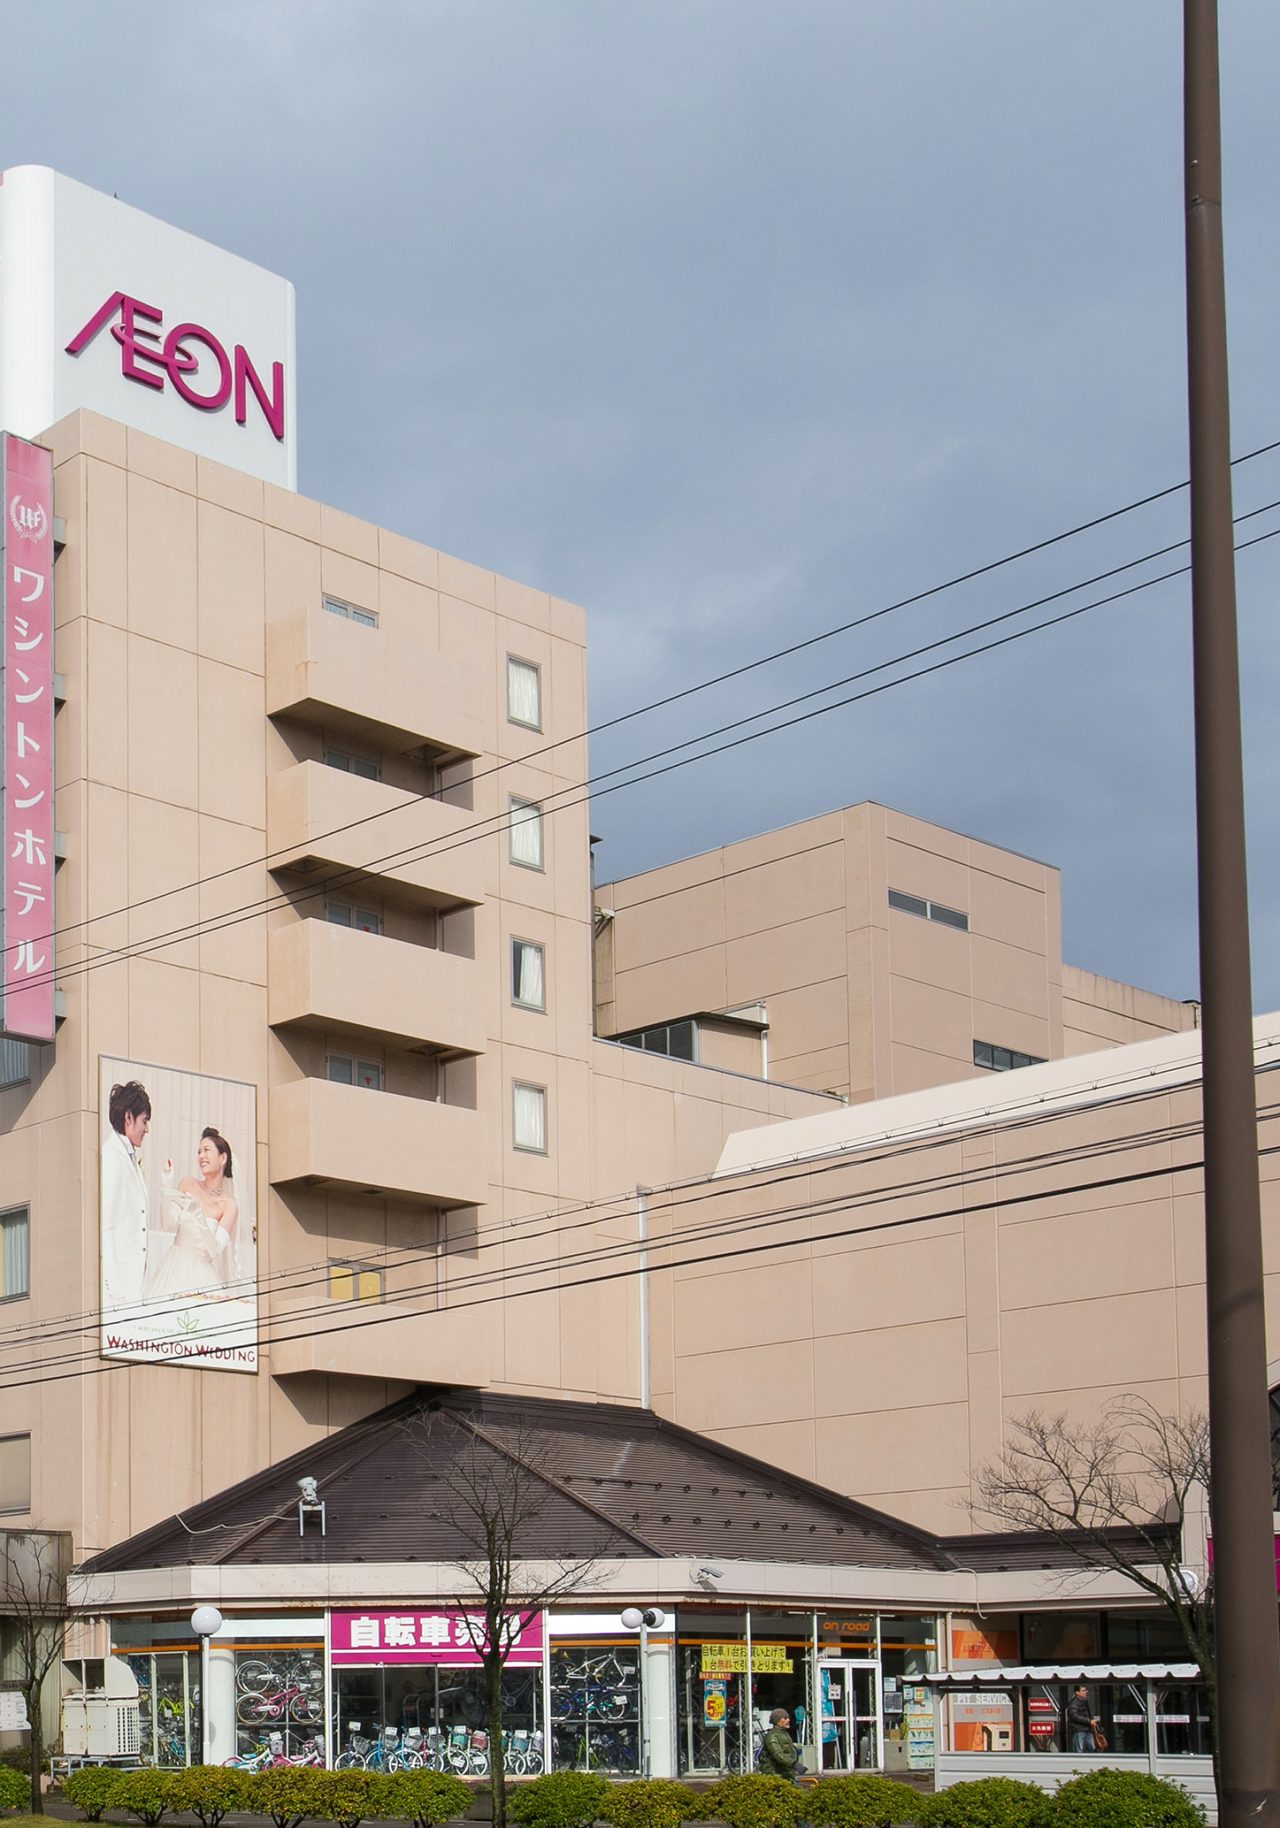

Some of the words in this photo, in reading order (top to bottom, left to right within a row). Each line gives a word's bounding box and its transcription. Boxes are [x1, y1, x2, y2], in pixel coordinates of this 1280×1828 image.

[10, 565, 46, 975] ワシントンホテル
[106, 1334, 192, 1356] WASHINGTON
[957, 1693, 971, 1704] PIT
